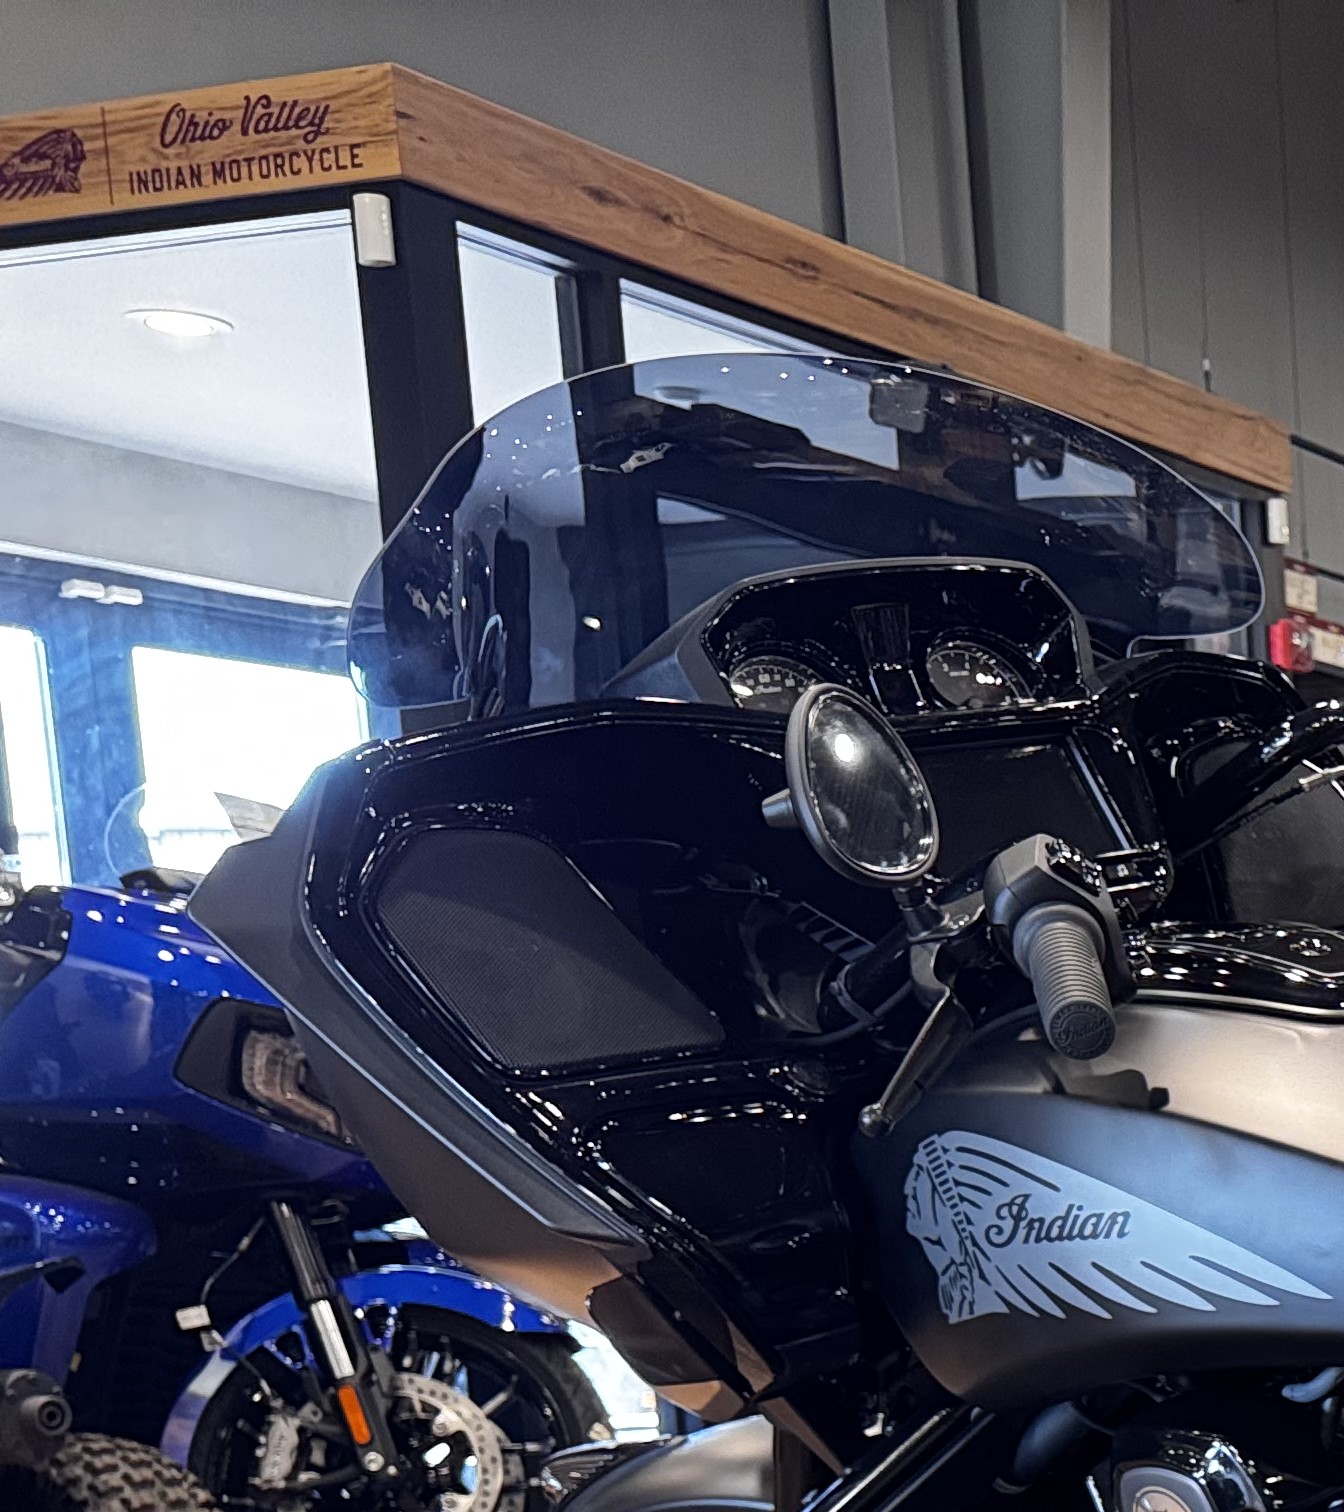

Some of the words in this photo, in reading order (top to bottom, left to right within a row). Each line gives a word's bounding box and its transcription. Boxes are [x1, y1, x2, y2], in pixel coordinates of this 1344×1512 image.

[160, 102, 233, 149] Ohio
[240, 94, 330, 144] Valley
[128, 163, 203, 196] INDIAN
[211, 143, 364, 186] MOTORCYCLE
[985, 1193, 1131, 1248] Indian
